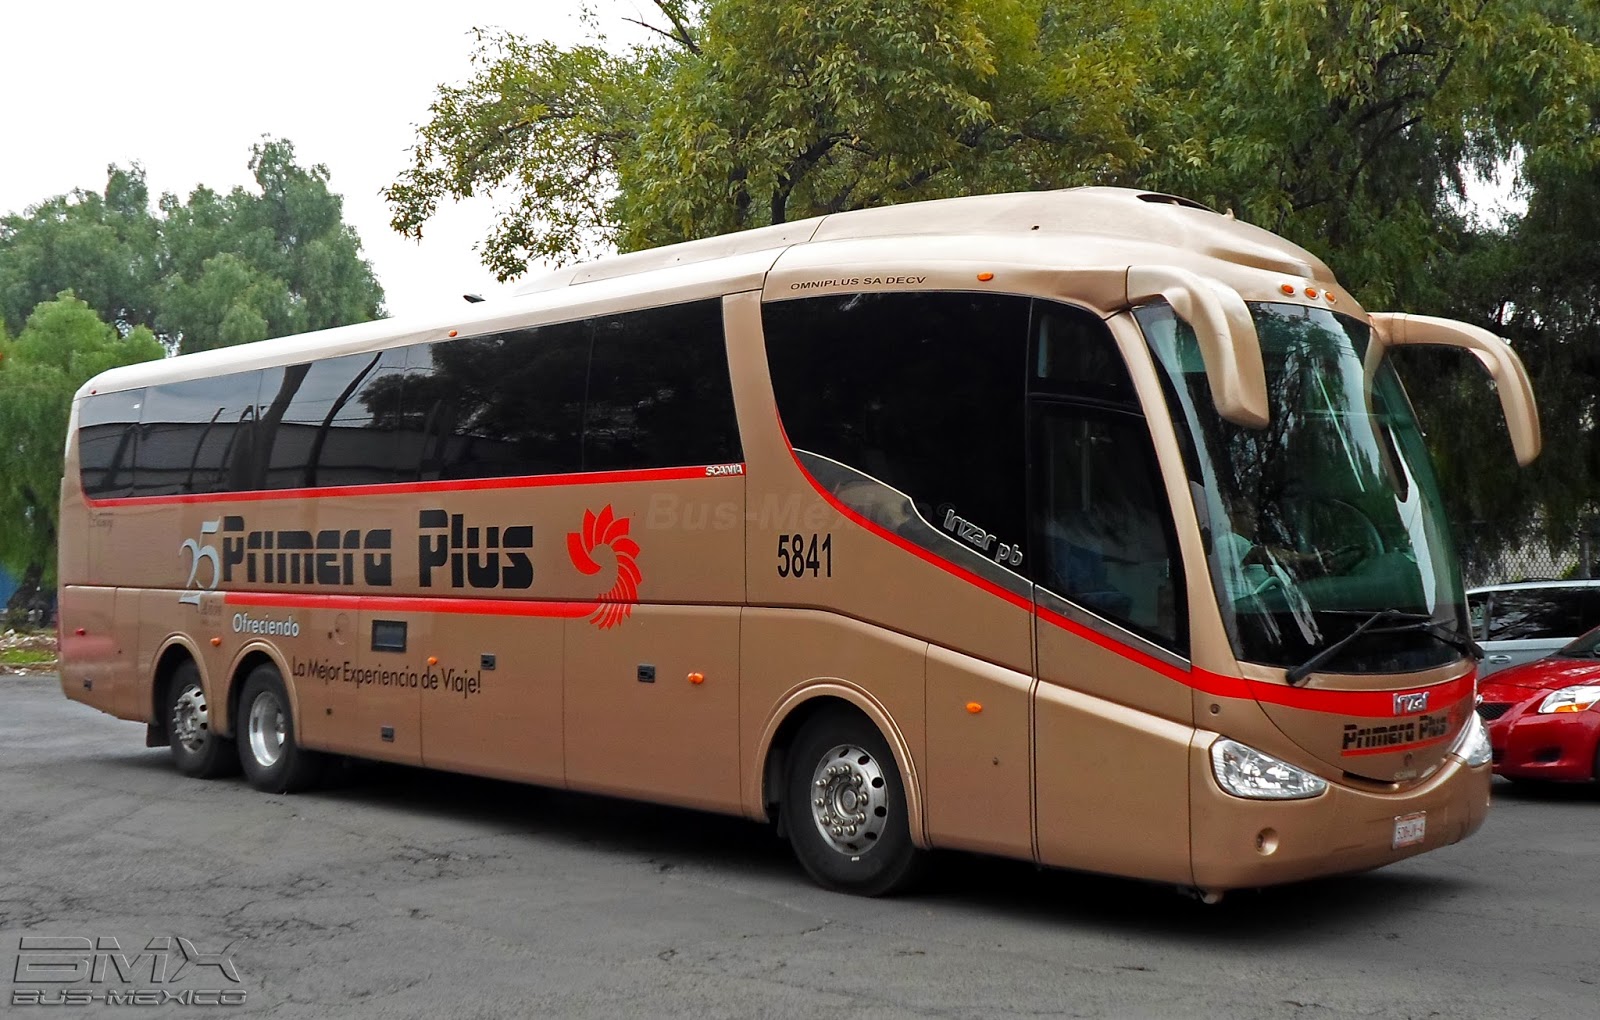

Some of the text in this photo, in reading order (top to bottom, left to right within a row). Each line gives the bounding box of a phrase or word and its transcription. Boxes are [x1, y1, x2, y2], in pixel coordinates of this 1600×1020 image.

[790, 278, 860, 291] OMNIPLUS
[863, 277, 882, 285] SA
[705, 464, 743, 476] SCANIA
[222, 509, 534, 589] Primera Plus
[777, 532, 833, 578] 5841
[943, 508, 1024, 566] Irizar pb
[178, 515, 220, 606] 25
[232, 613, 299, 638] Ofreciendo
[292, 656, 482, 699] La Mejor Experiencia de Viaje!
[1342, 715, 1447, 750] Primera Plus
